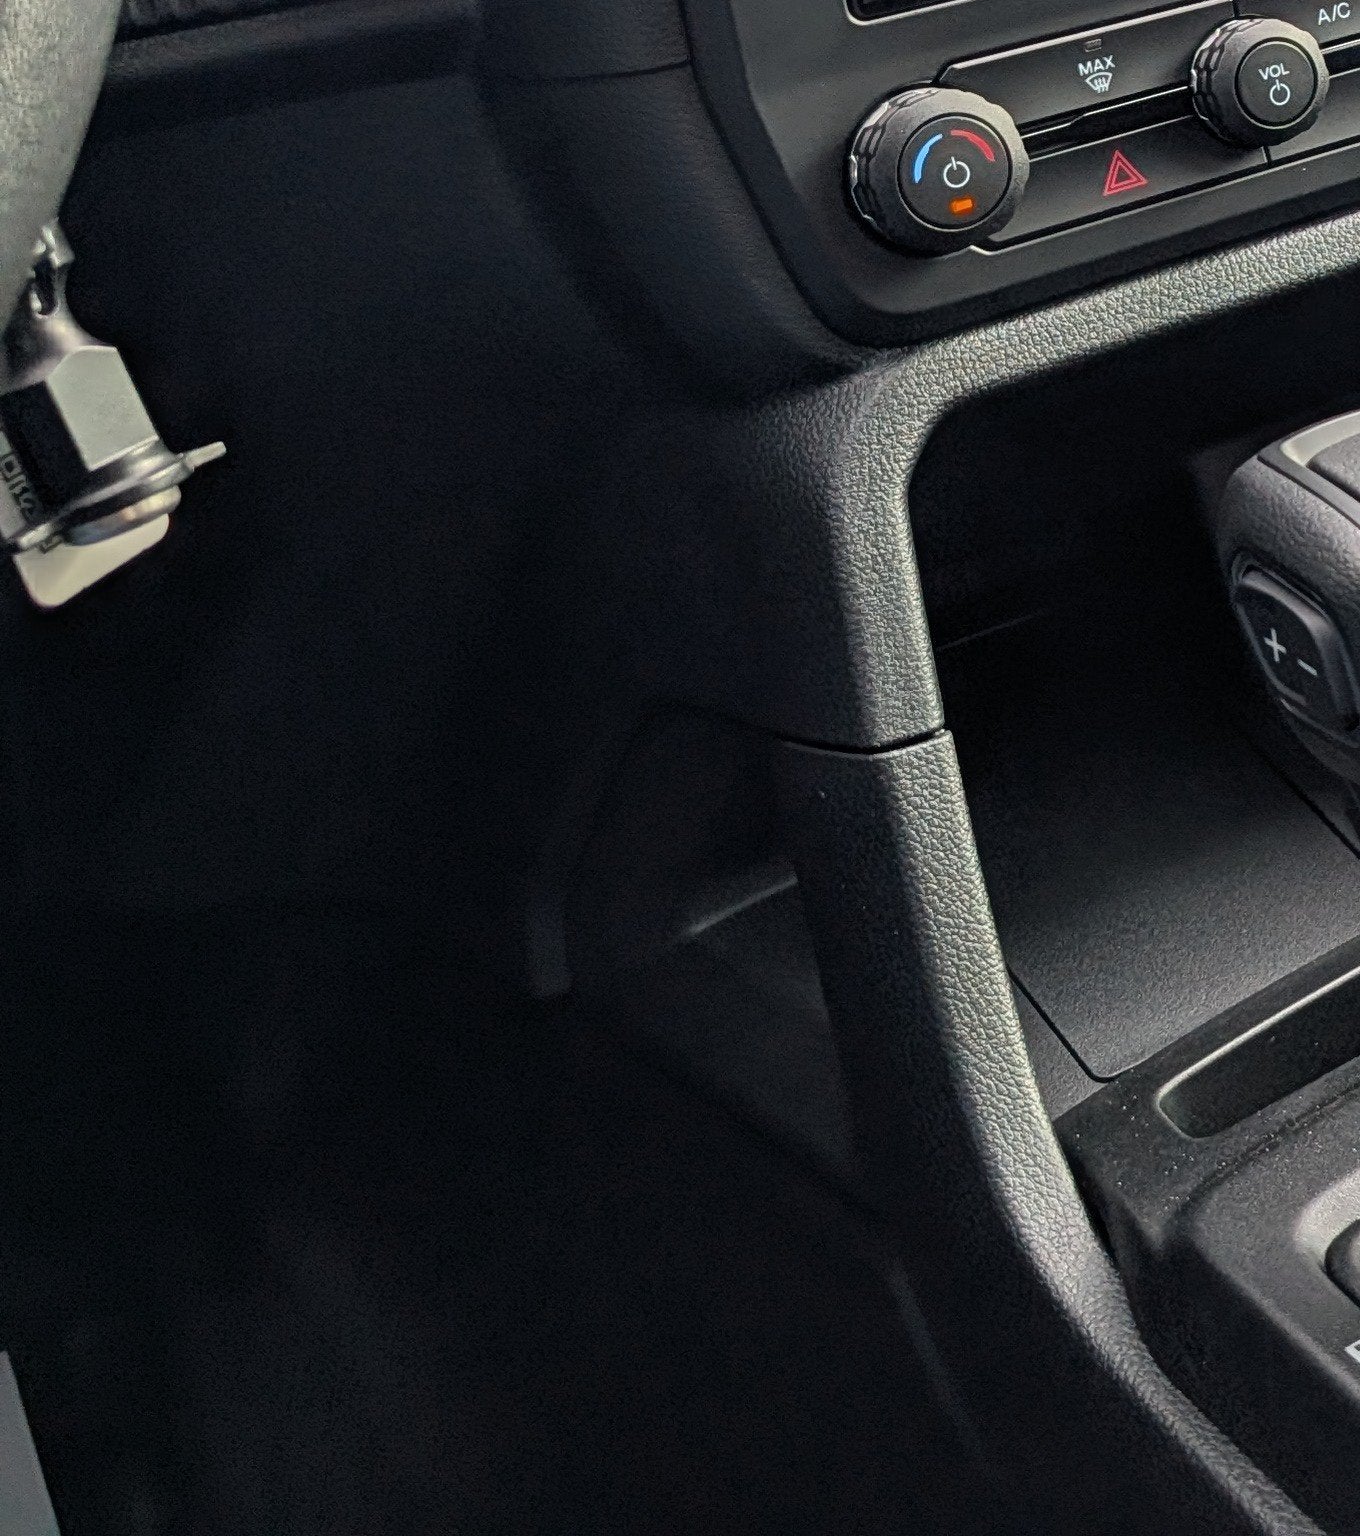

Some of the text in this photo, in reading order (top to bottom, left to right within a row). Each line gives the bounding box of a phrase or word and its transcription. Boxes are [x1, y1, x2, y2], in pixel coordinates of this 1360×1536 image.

[1317, 1, 1351, 28] A/C
[1078, 55, 1115, 77] MAX
[1258, 64, 1290, 86] VOL
